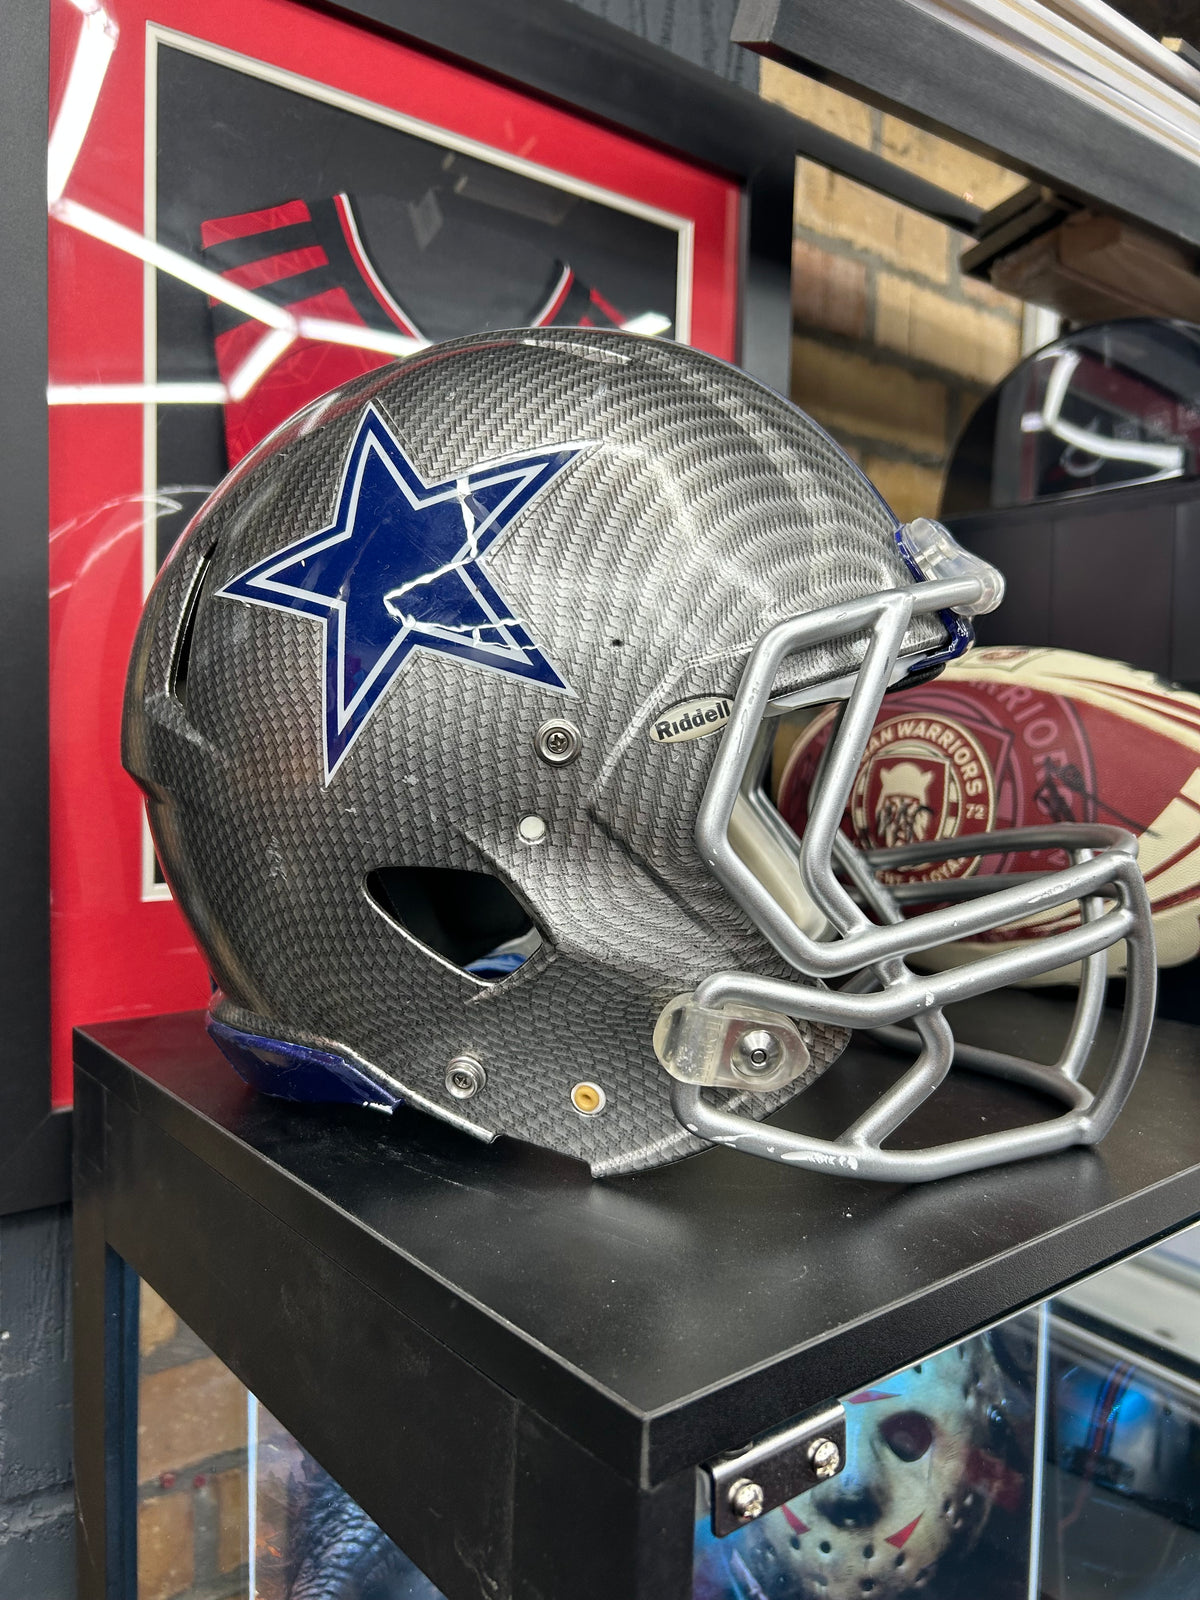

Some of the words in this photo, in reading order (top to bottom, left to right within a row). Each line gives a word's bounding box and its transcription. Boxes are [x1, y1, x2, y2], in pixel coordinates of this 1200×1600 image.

[654, 700, 731, 741] Riddell
[896, 720, 983, 797] WARRIORS
[966, 803, 985, 819] 72
